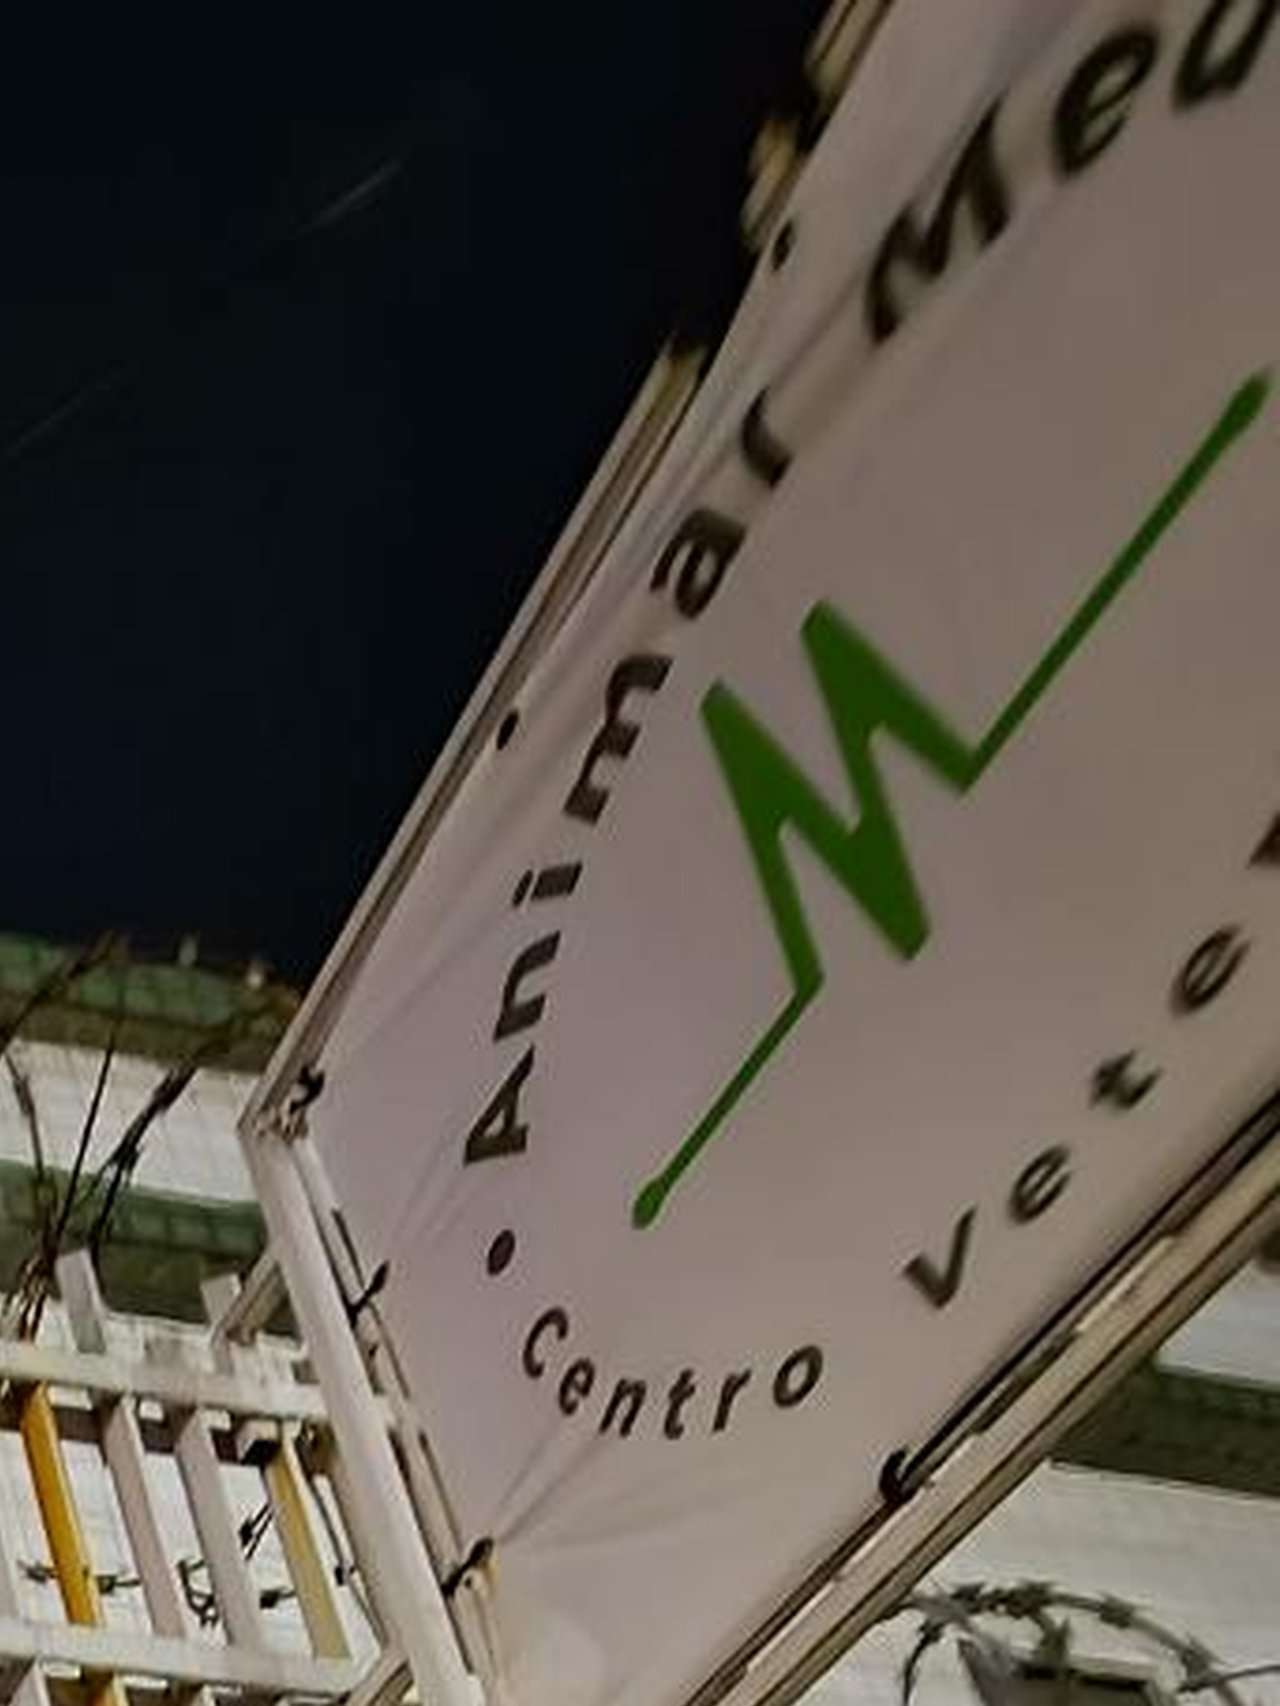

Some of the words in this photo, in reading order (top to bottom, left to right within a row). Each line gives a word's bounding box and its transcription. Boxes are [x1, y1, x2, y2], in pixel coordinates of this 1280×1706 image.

[463, 390, 793, 1164] Animar
[522, 1306, 824, 1442] Centro
[902, 806, 1280, 1312] Vete
